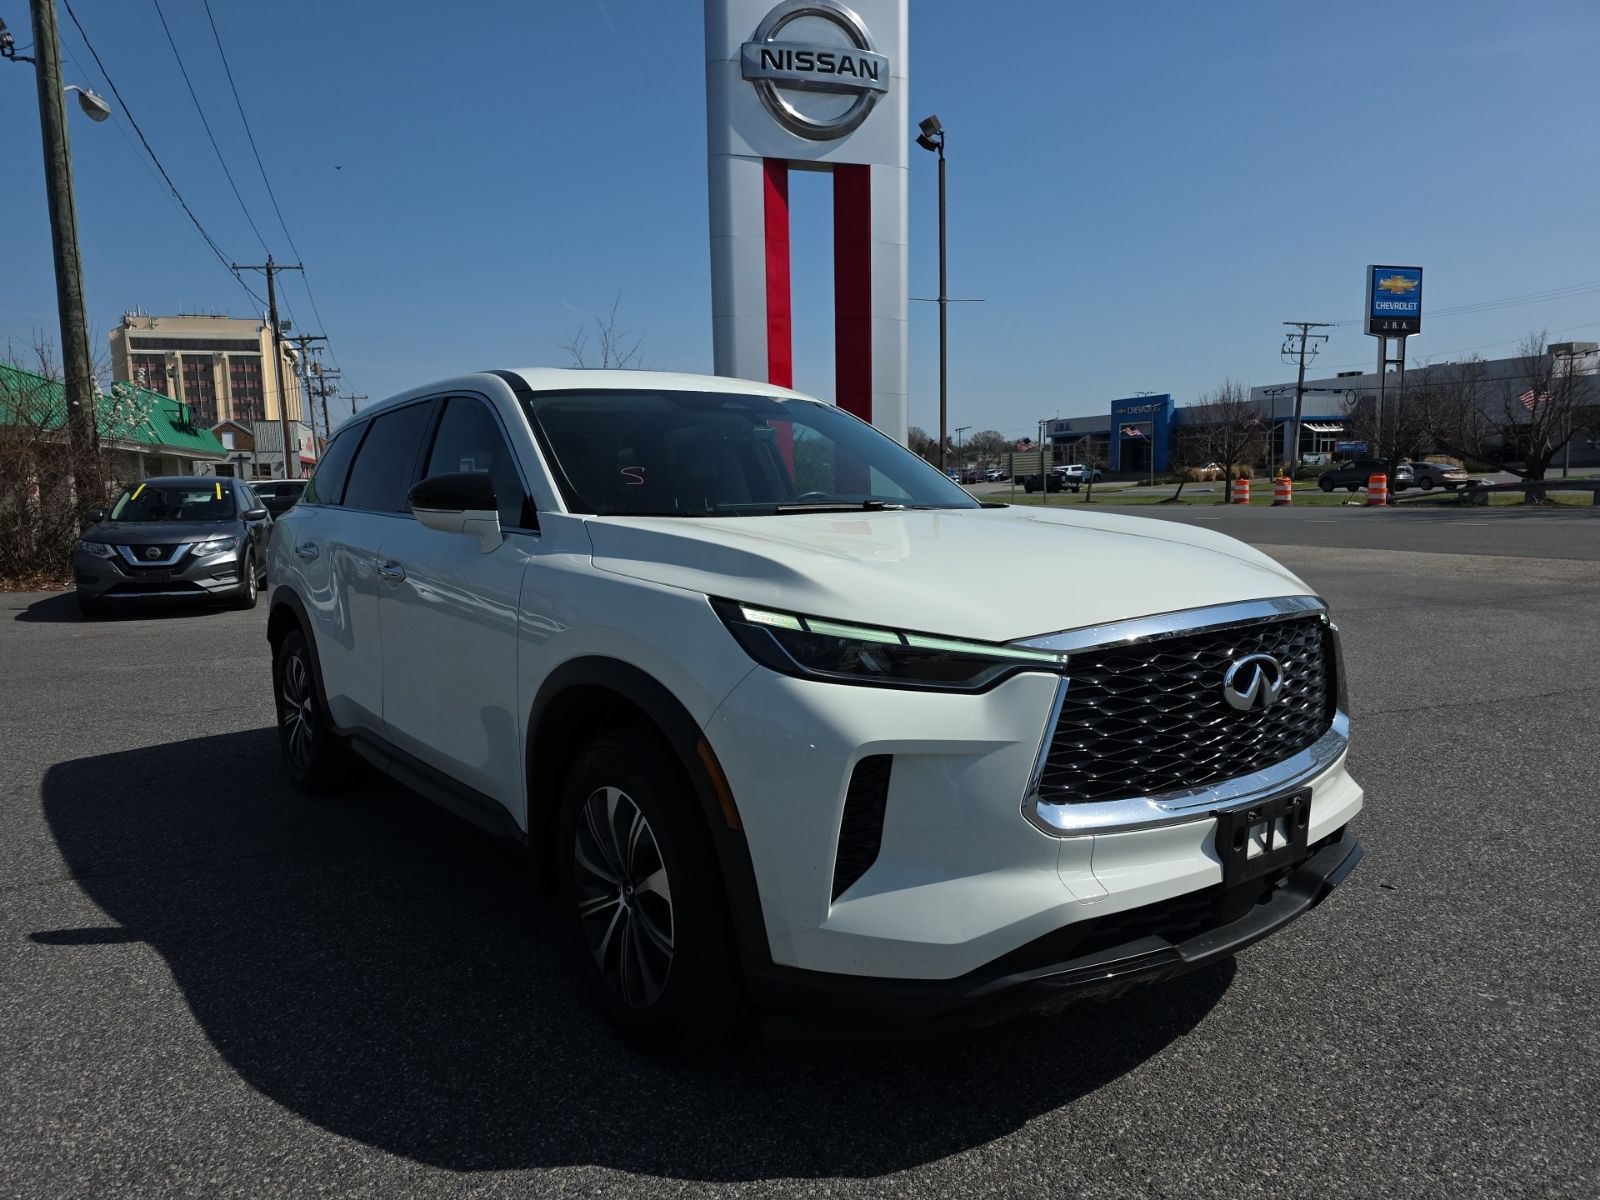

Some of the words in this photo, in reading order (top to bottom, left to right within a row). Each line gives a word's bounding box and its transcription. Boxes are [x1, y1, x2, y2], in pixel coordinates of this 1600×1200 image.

[761, 49, 878, 81] NISSAN
[1375, 301, 1418, 311] CHEVROLET
[620, 466, 645, 485] S
